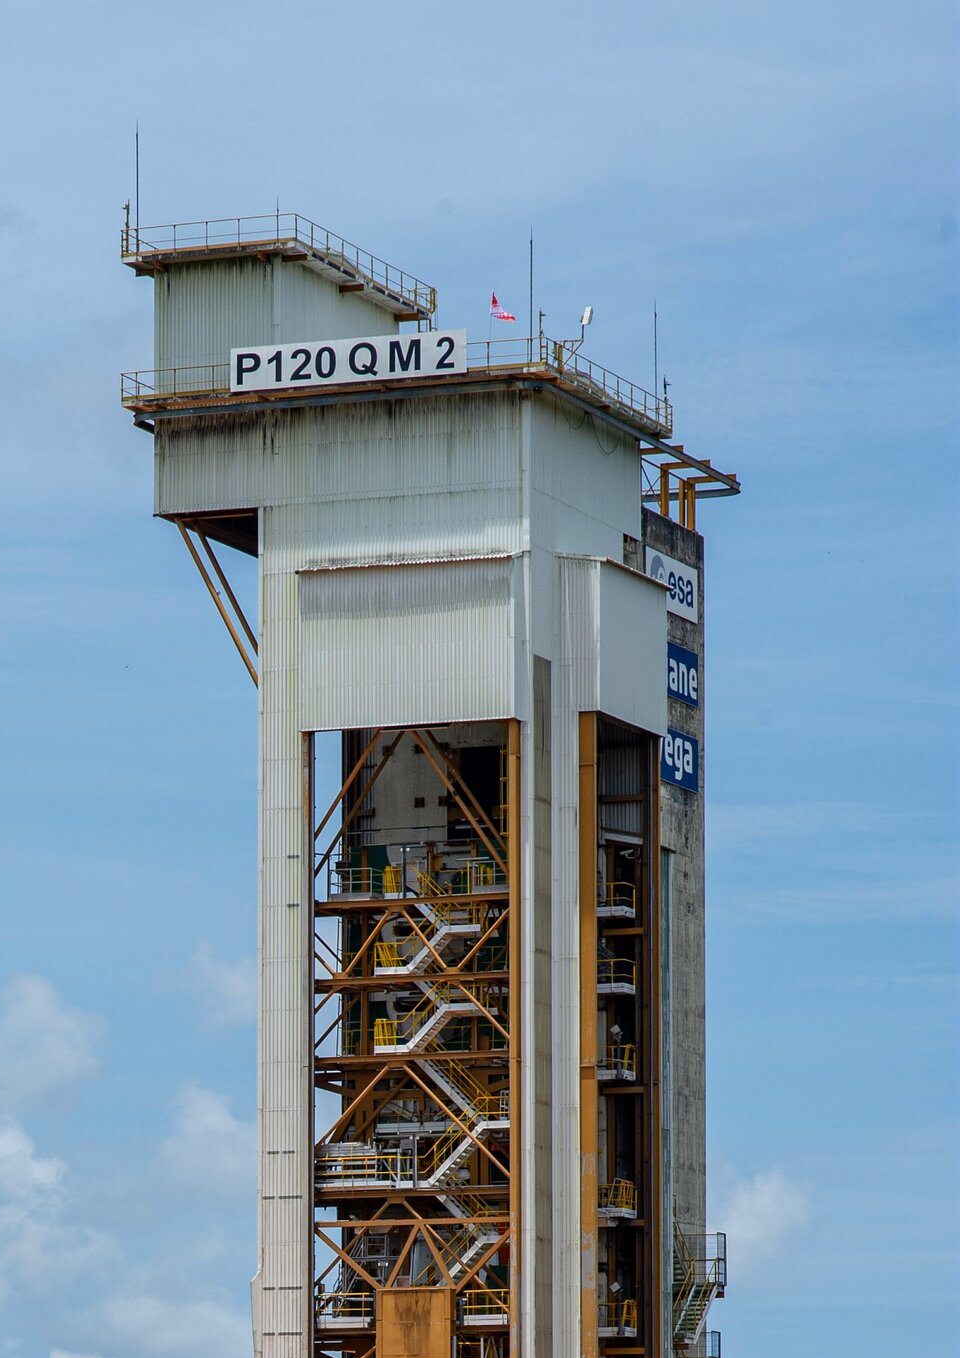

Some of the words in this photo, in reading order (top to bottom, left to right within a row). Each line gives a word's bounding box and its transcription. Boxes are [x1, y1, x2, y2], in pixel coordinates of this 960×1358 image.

[236, 346, 337, 386] P120
[668, 570, 694, 609] esa
[667, 658, 698, 701] ane
